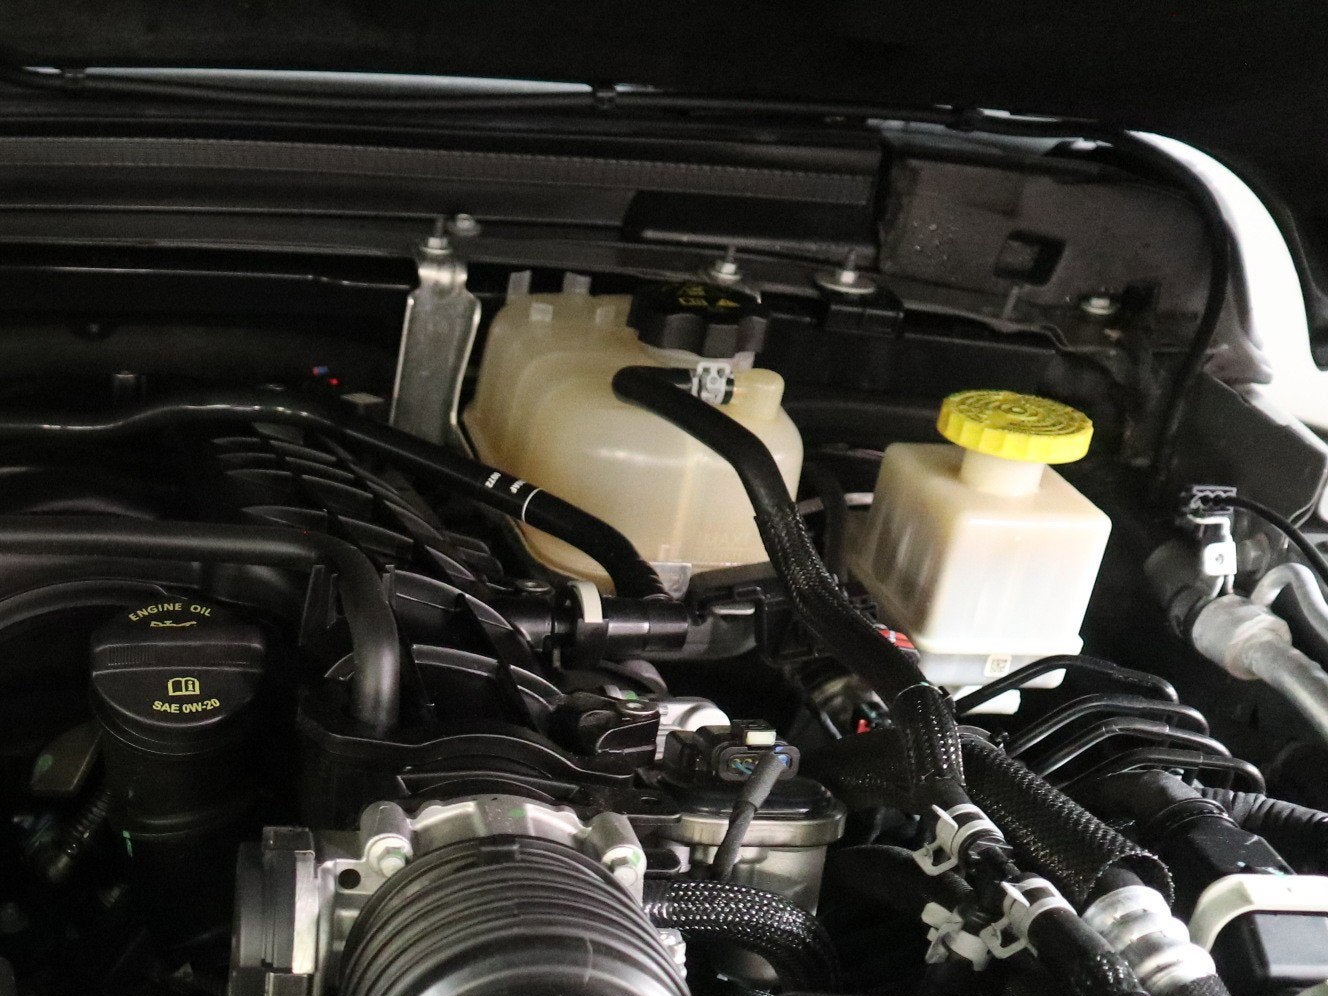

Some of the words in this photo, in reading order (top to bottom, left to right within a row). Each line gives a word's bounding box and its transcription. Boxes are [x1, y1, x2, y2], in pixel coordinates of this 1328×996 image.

[128, 602, 183, 622] ENGINE
[190, 604, 212, 617] OIL
[152, 700, 179, 714] SAE
[182, 698, 221, 714] 0W-20
